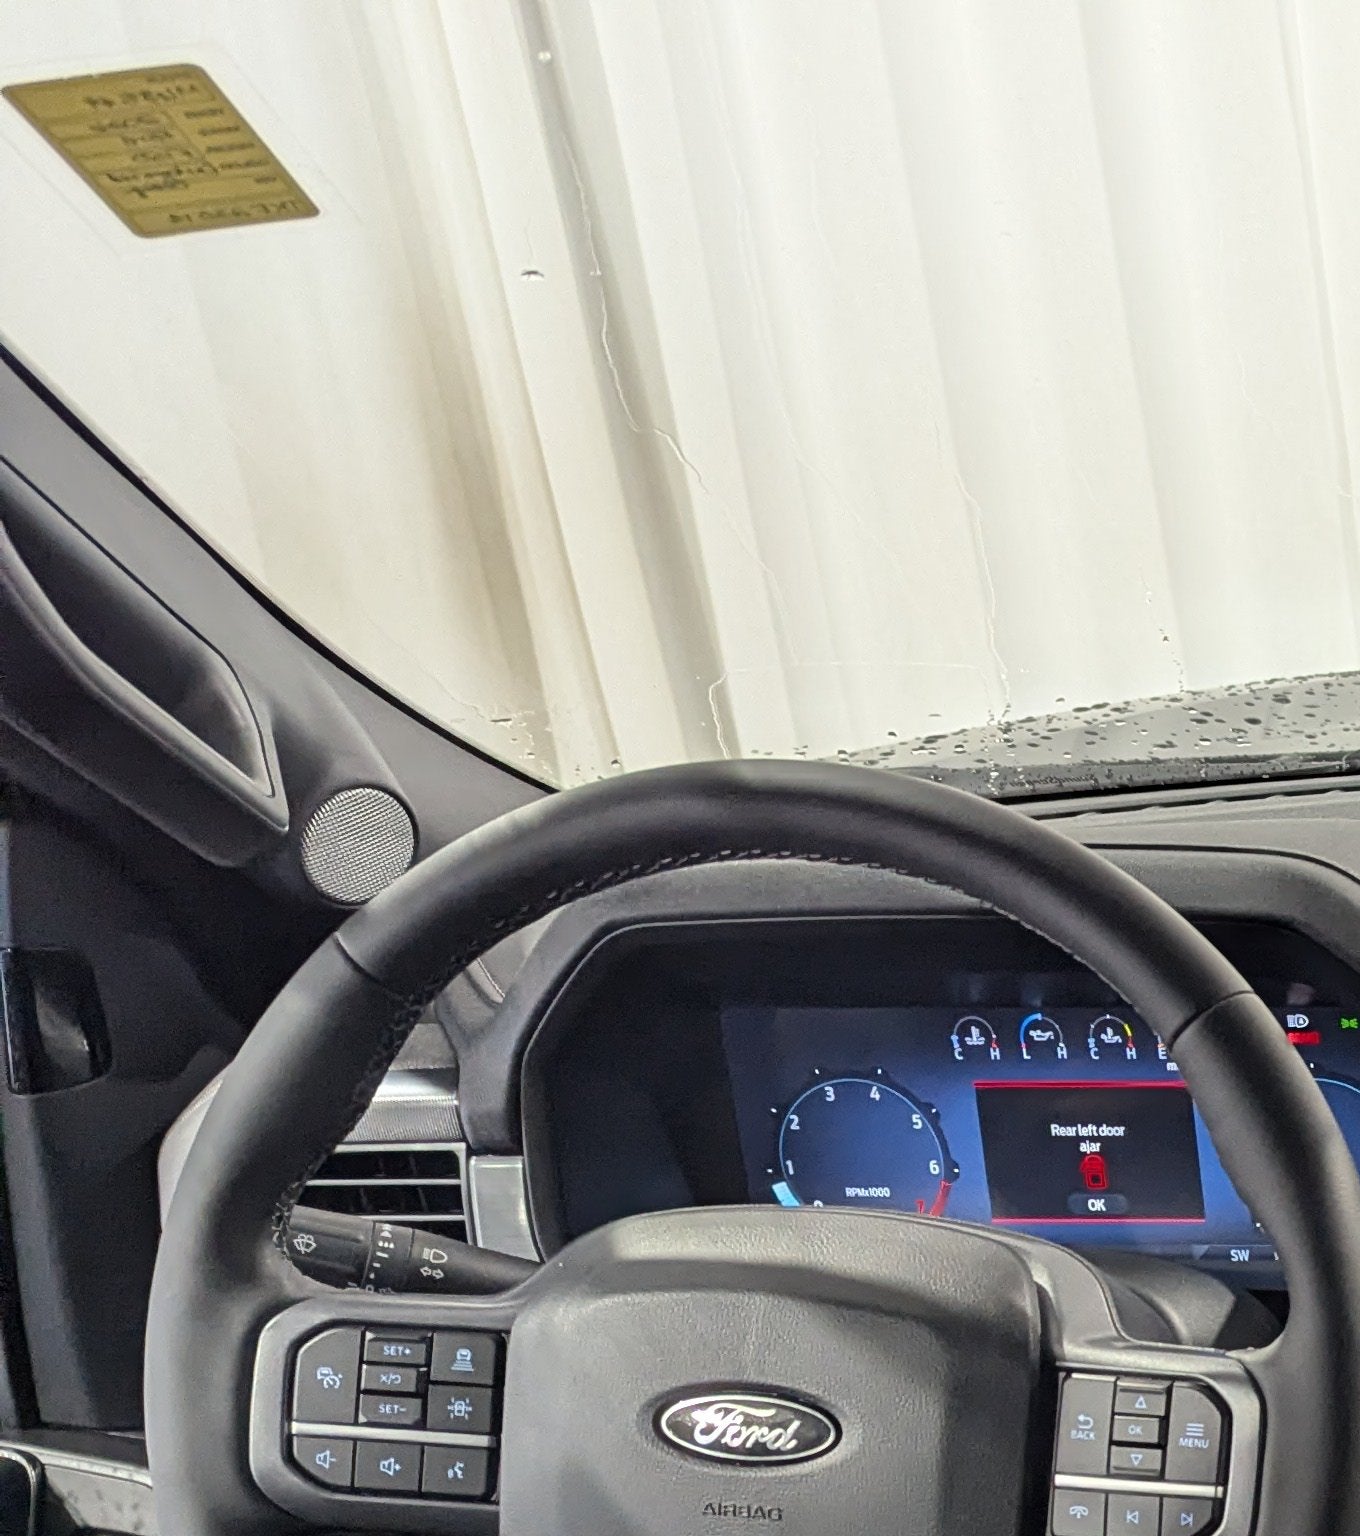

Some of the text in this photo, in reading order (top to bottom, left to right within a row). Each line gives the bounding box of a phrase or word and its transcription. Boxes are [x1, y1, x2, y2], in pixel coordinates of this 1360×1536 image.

[954, 1048, 963, 1059] C
[990, 1048, 1000, 1059] H
[1023, 1048, 1031, 1059] L
[1058, 1048, 1068, 1060] H
[1090, 1048, 1099, 1059] C
[1126, 1048, 1136, 1059] H
[1157, 1047, 1167, 1060] E
[825, 1086, 835, 1102] 3
[869, 1086, 880, 1101] 4
[789, 1114, 800, 1130] 2
[912, 1114, 923, 1129] 5
[1051, 1124, 1126, 1137] Rear left door
[1079, 1140, 1102, 1154] ajar
[785, 1160, 794, 1175] 1
[928, 1160, 940, 1175] 6
[845, 1187, 890, 1198] RPMx1000
[1087, 1199, 1107, 1212] OK
[1230, 1250, 1249, 1262] SW
[691, 1402, 802, 1451] Ford
[1128, 1425, 1142, 1435] OK
[1071, 1430, 1095, 1440] BACK
[1179, 1437, 1209, 1448] MENU
[703, 1502, 783, 1521] AIRBAG
